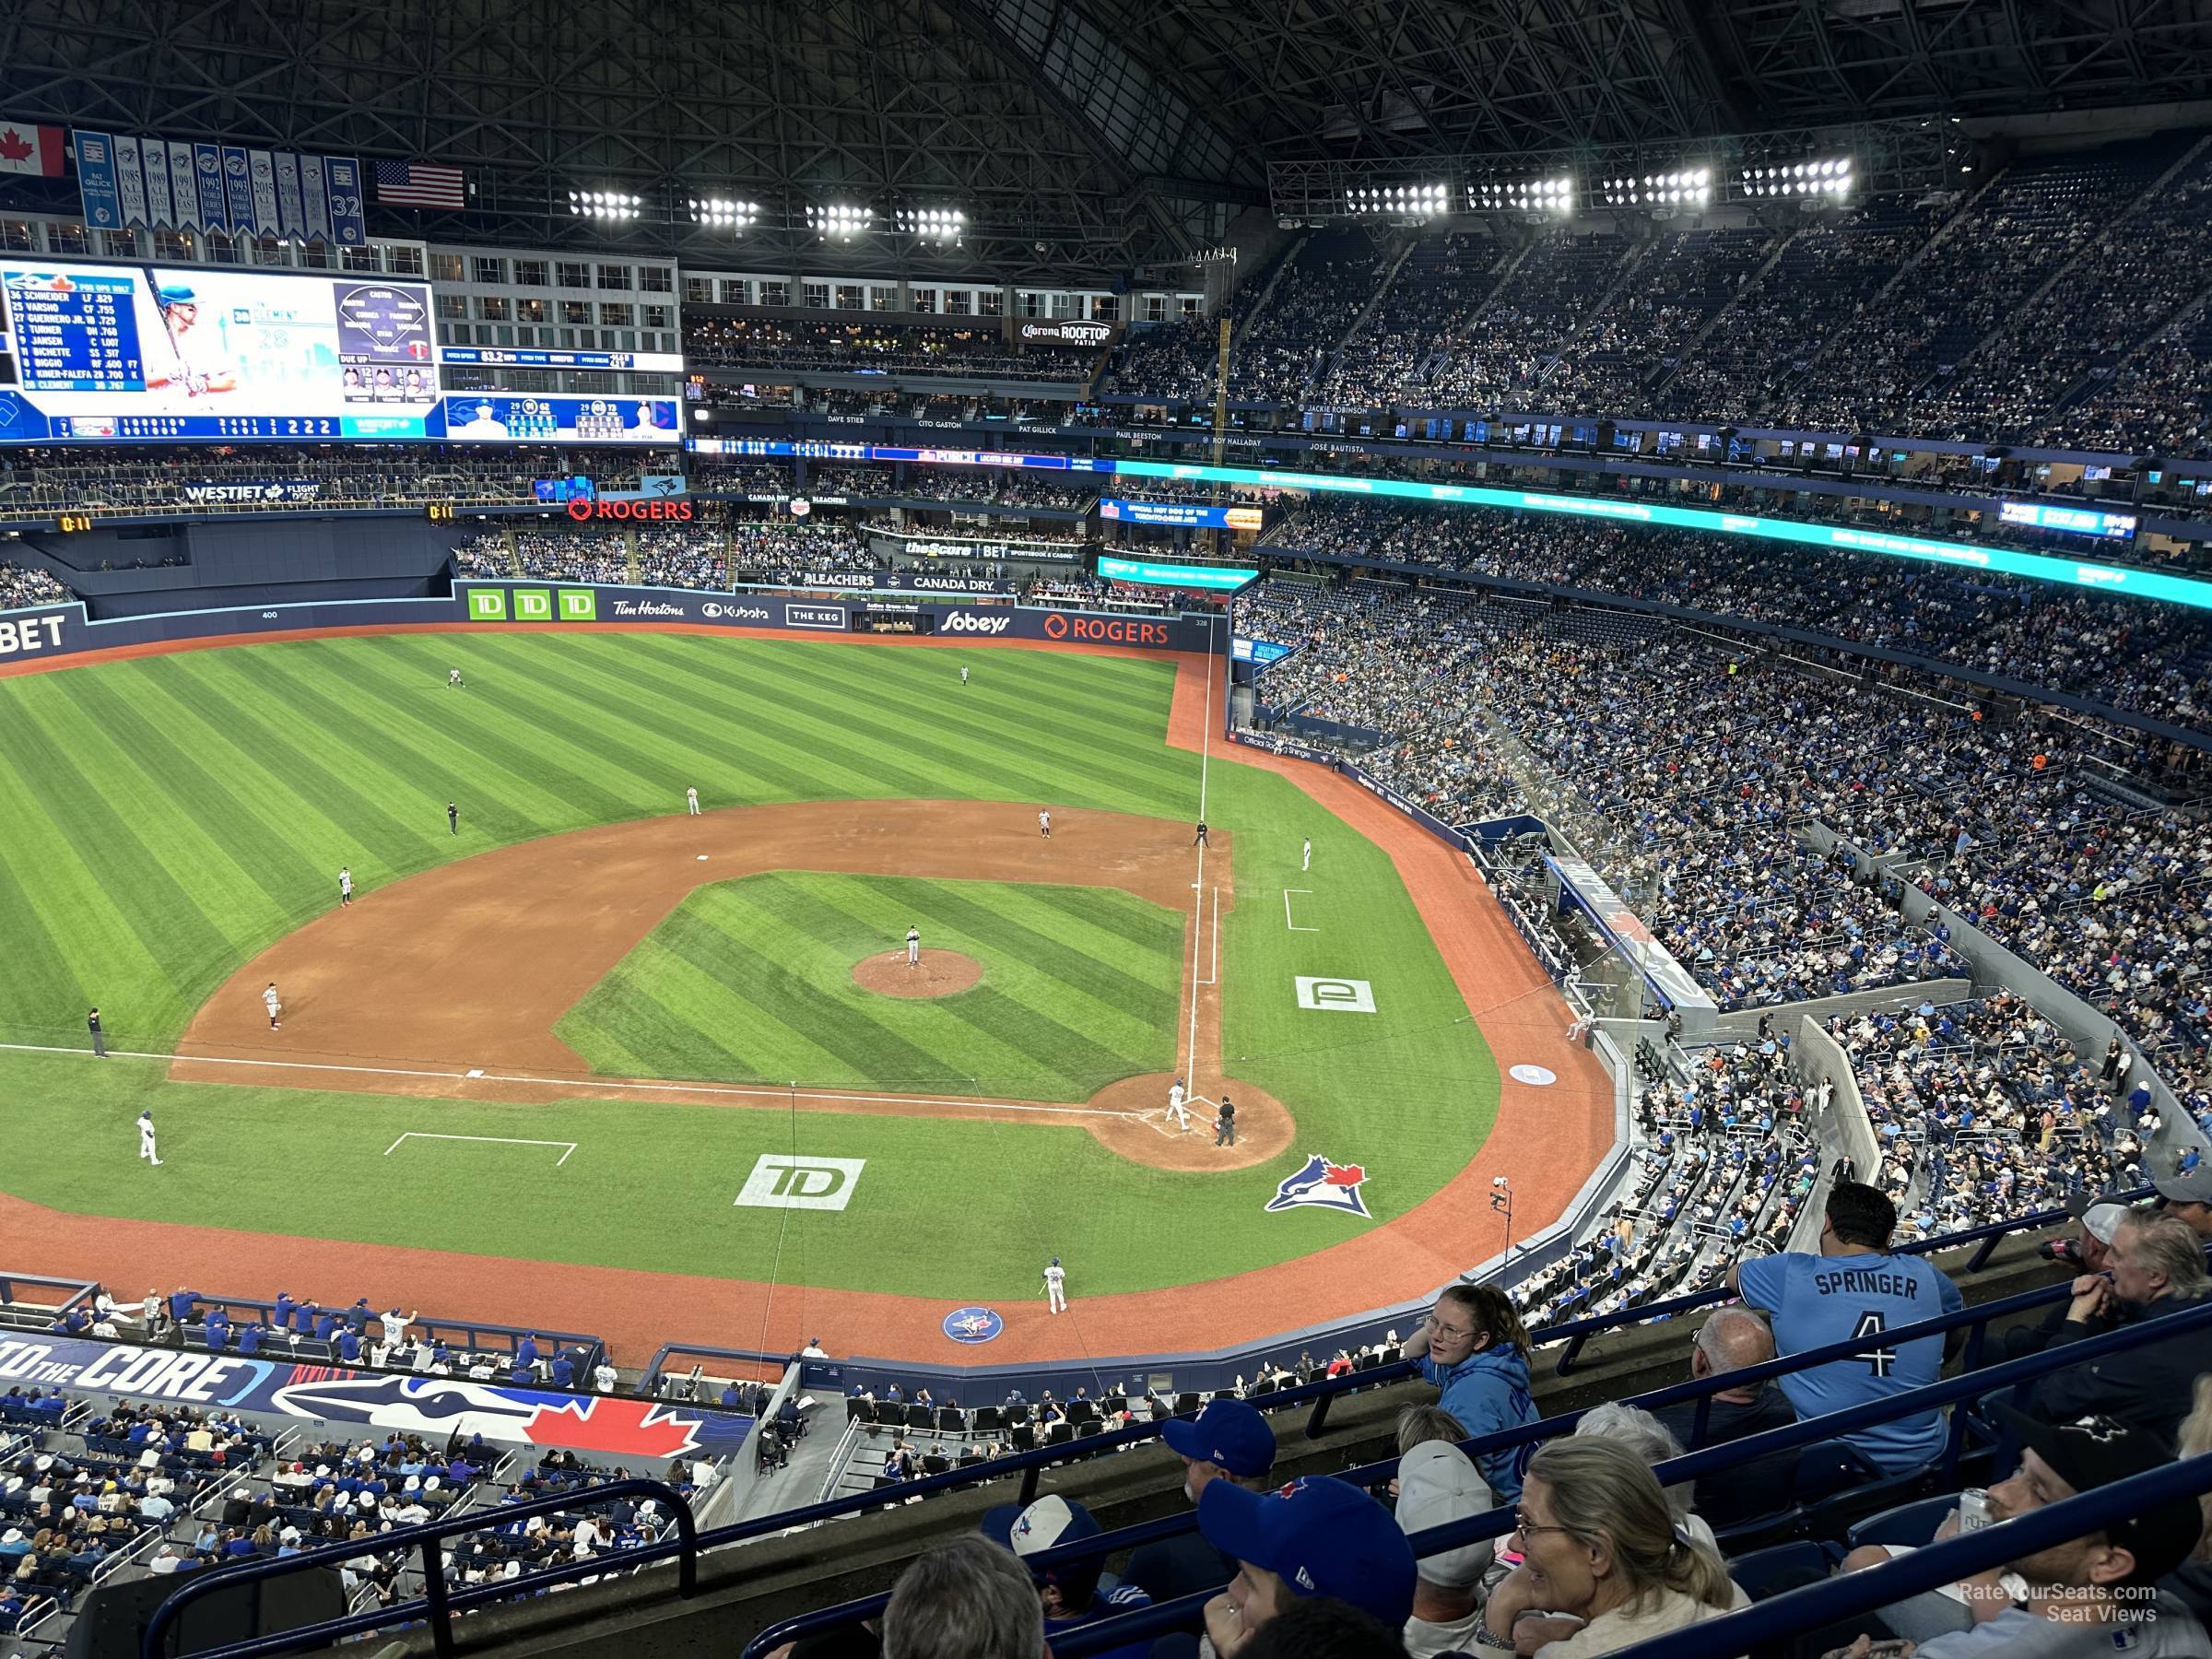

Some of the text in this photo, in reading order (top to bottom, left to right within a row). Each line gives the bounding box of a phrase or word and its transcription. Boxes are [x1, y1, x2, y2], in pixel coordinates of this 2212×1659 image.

[121, 169, 140, 182] 1985
[148, 172, 166, 184] 1989
[175, 175, 193, 186] 1991
[85, 179, 111, 187] GILLICK
[201, 177, 220, 190] 1992
[230, 180, 248, 192] 1993
[254, 182, 273, 193] 2015
[280, 184, 299, 195] 2016
[124, 194, 142, 203] EAST
[151, 196, 168, 205] EAST
[177, 199, 195, 208] EAST
[203, 200, 222, 209] SERIES
[332, 195, 361, 217] 32
[11, 291, 113, 303] 36 SCHNEIDER LF .829
[369, 291, 393, 299] CASTRO
[12, 302, 115, 314] 25 VARSHO CF .755
[14, 313, 116, 325] 27 GUERRERO JR. .729
[253, 309, 298, 321] CLEMENT
[18, 324, 98, 335] 2 TURNER DH
[1022, 324, 1110, 340] Corona ROOFTOP
[20, 336, 26, 345] 9
[31, 336, 63, 346] JANSEN
[91, 338, 97, 347] C
[258, 329, 289, 349] 28
[21, 347, 119, 358] 11 BICHETTE SS .517
[481, 351, 504, 363] 83.2
[35, 359, 63, 368] BIGGIO
[92, 359, 102, 368] RF
[105, 360, 122, 369] .600
[25, 370, 31, 378] 7
[36, 370, 92, 379] KINER-FALEFA
[107, 371, 124, 379] .700
[131, 371, 138, 379] K
[362, 368, 372, 377] 12
[38, 381, 74, 390] CLEMENT
[1332, 406, 1368, 414] ROBINSON
[288, 420, 330, 434] 2 2 2
[1032, 426, 1057, 434] GILLICK
[1133, 432, 1162, 441] BEESTON
[1227, 438, 1261, 447] HALLADAY
[1310, 442, 1365, 453] JOSÉ BAUTISTA
[935, 451, 975, 464] PORCH
[185, 485, 265, 501] WESTJET
[287, 484, 320, 495] FLIGHT
[747, 494, 774, 502] CANADA
[429, 506, 453, 520] 0:11
[598, 501, 693, 521] ROGERS
[60, 517, 91, 532] 0:11
[905, 542, 971, 556] theScore
[983, 545, 1007, 558] BET
[805, 573, 874, 587] BLEACHERS
[914, 577, 966, 589] CANADA
[969, 580, 995, 592] DRY.
[473, 594, 503, 615] TD
[518, 594, 547, 615] TD
[562, 594, 592, 615] TD
[613, 600, 685, 617] Tim Hortons
[262, 611, 277, 619] 400
[723, 605, 769, 620] Kubota
[793, 612, 839, 621] THE KEG
[941, 611, 1011, 634] Sobeys
[0, 615, 65, 654] BET
[1073, 618, 1169, 644] ROGERS
[1244, 736, 1264, 747] Official
[1288, 747, 1311, 759] Shingle
[765, 1165, 846, 1198] TD
[1815, 1272, 1918, 1300] SPRINGER
[386, 1324, 396, 1334] 20
[1845, 1311, 1897, 1377] 4
[27, 1361, 83, 1383] THE
[75, 1345, 253, 1401] CORE
